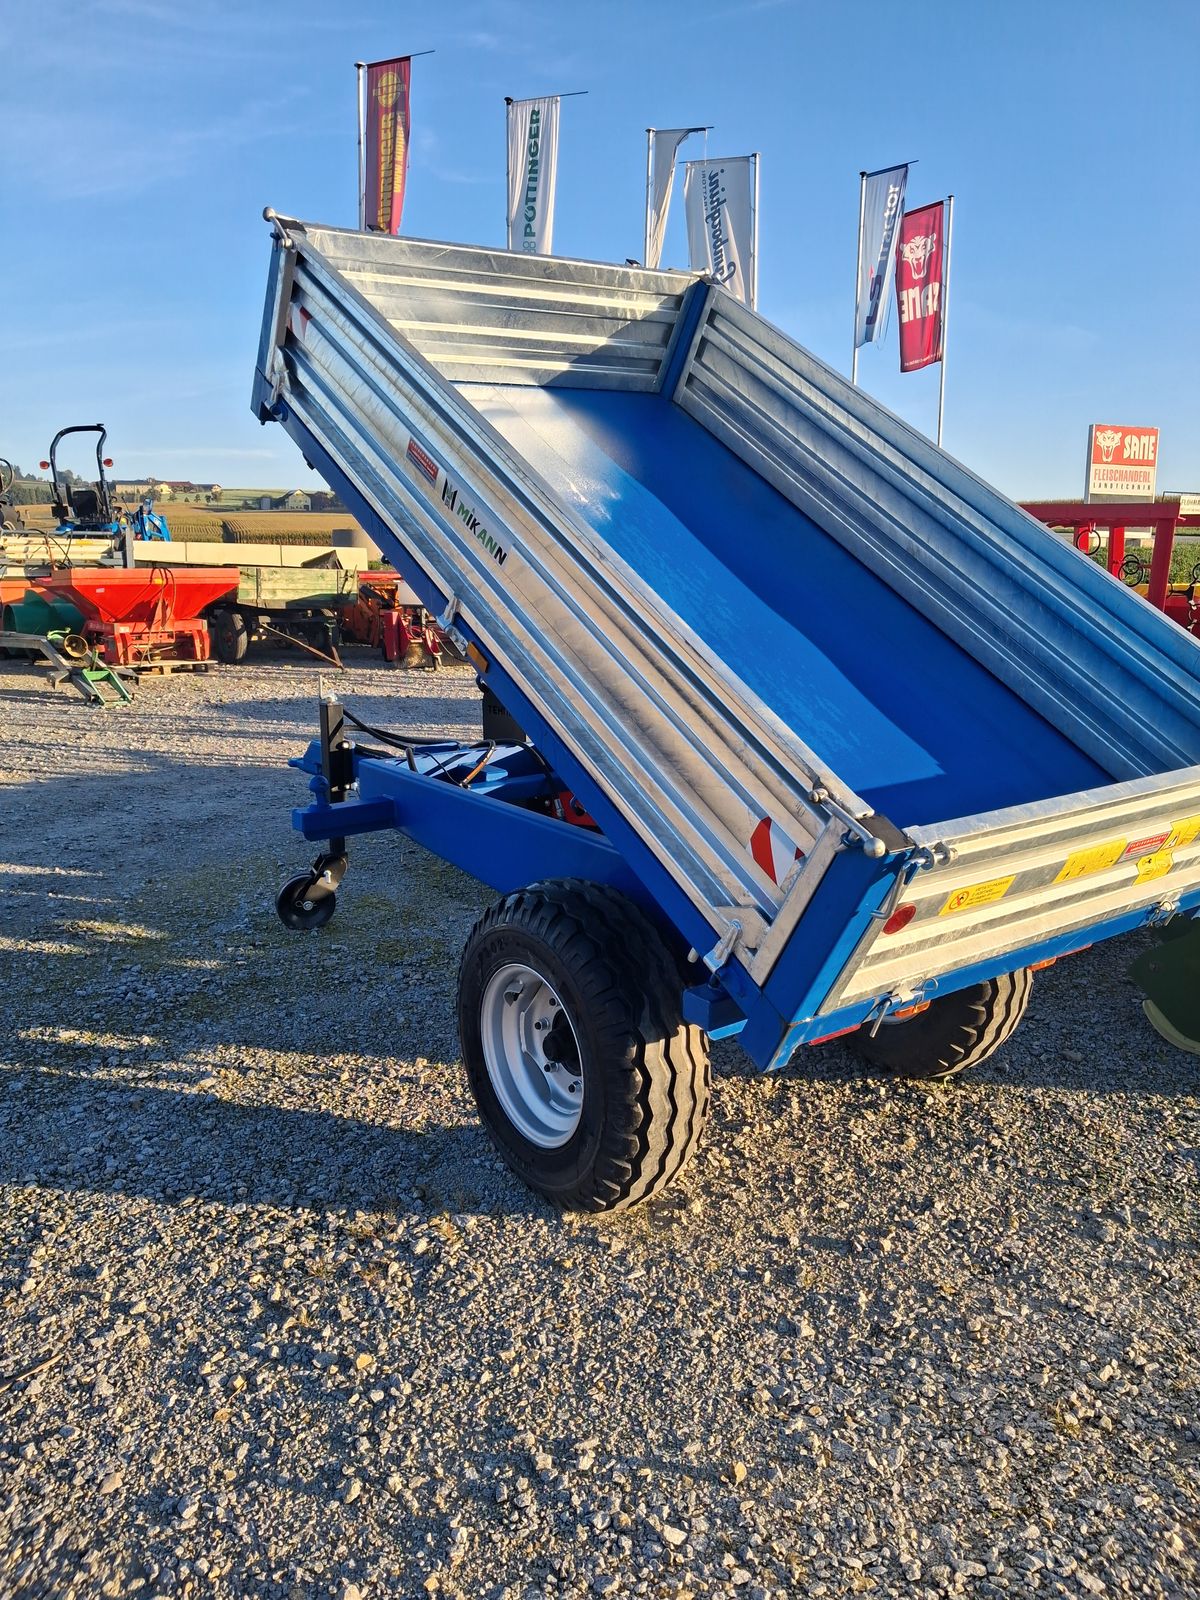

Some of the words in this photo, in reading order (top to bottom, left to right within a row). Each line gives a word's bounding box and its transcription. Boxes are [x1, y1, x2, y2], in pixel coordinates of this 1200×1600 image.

[523, 108, 541, 238] PÖTTINGER
[866, 275, 882, 326] LS
[878, 184, 900, 262] Tractor
[1093, 468, 1151, 483] FLEISCHANDERL
[1123, 434, 1156, 461] SAME
[456, 502, 508, 566] MIKANN
